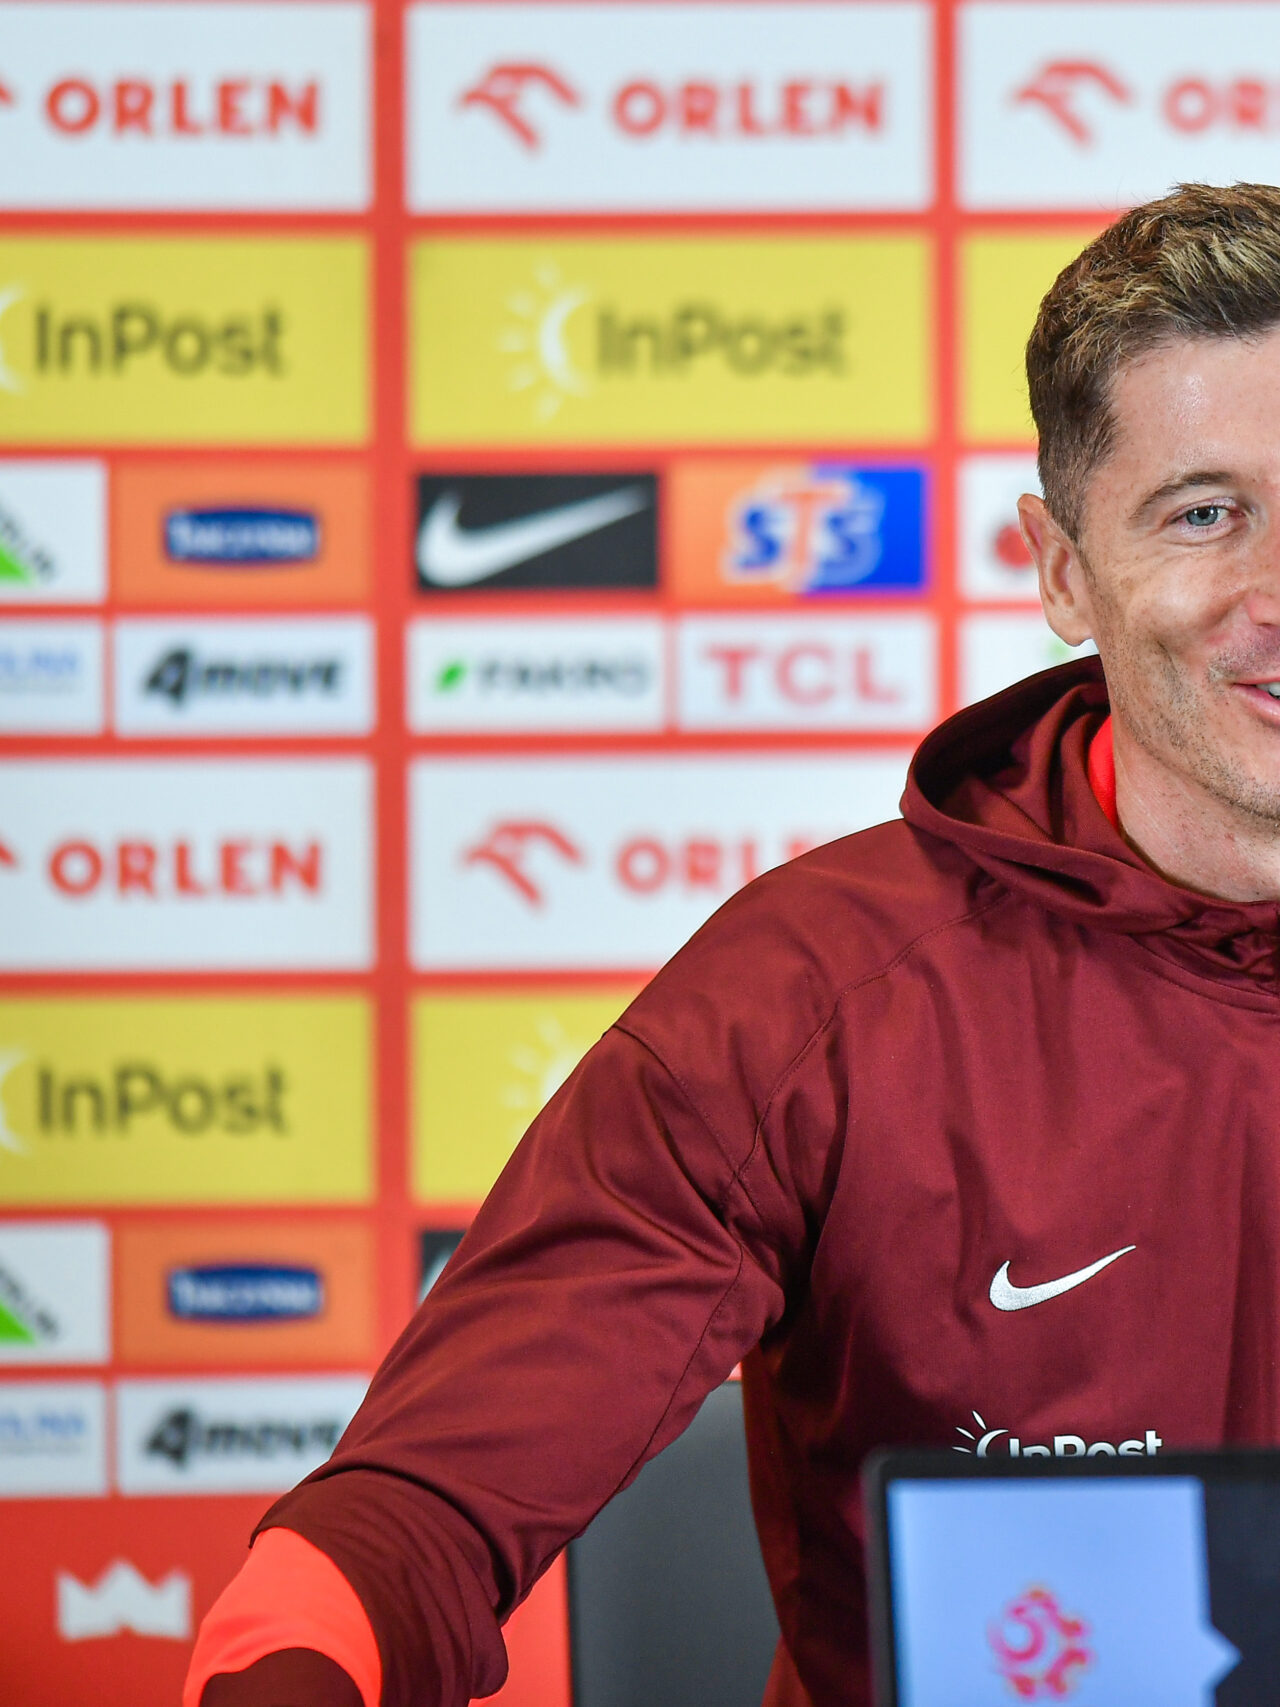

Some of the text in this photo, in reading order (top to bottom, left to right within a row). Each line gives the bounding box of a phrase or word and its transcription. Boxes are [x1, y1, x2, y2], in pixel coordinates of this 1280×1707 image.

[44, 77, 319, 136] ORLEN
[611, 77, 885, 139] ORLEN
[33, 301, 285, 376] InPost
[595, 300, 847, 376] InPost
[722, 469, 883, 591] STS
[704, 642, 899, 705] TCL
[46, 838, 322, 898] ORLEN
[616, 834, 824, 895] ORL
[34, 1060, 287, 1139] InPost
